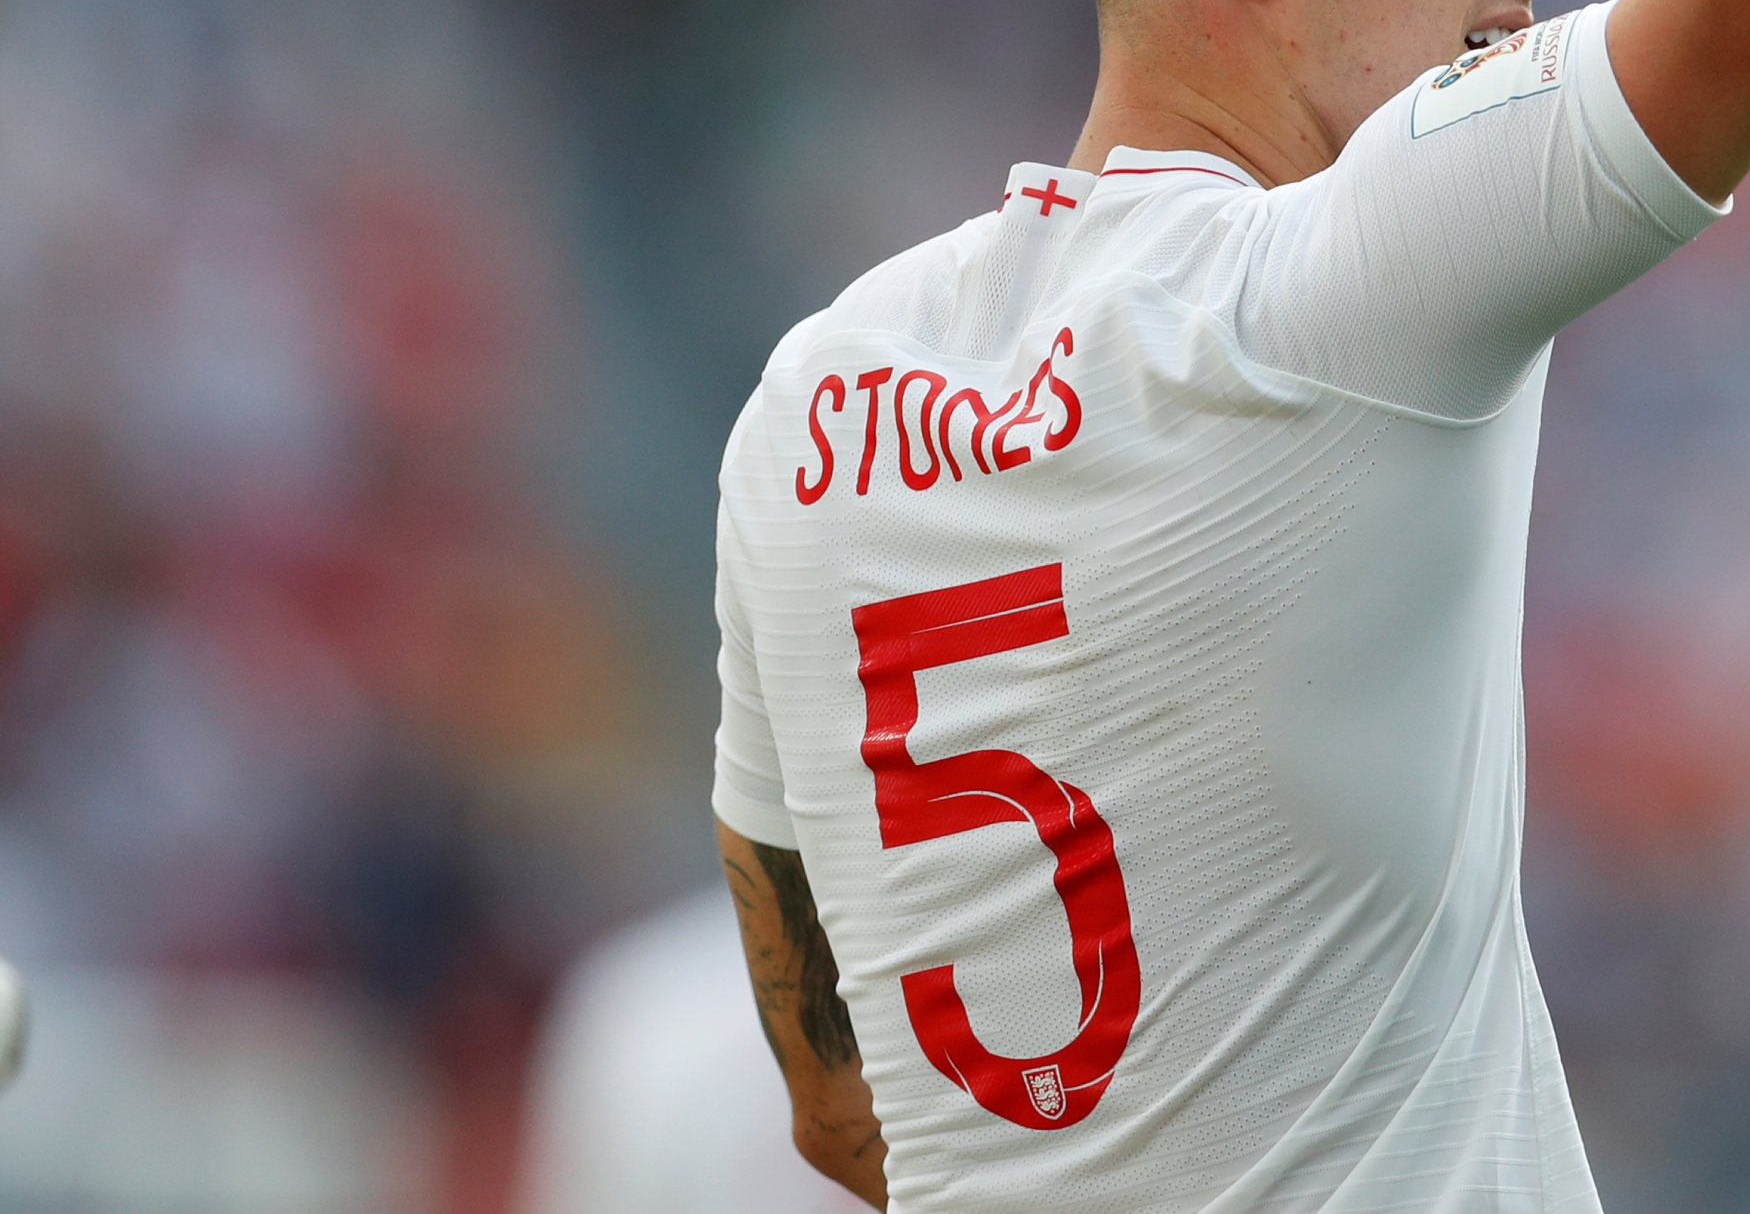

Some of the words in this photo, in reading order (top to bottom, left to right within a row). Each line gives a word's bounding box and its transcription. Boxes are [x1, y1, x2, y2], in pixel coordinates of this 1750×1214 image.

[1540, 22, 1563, 83] RUSSIA
[795, 327, 1082, 506] STONES
[851, 562, 1142, 1131] 5
